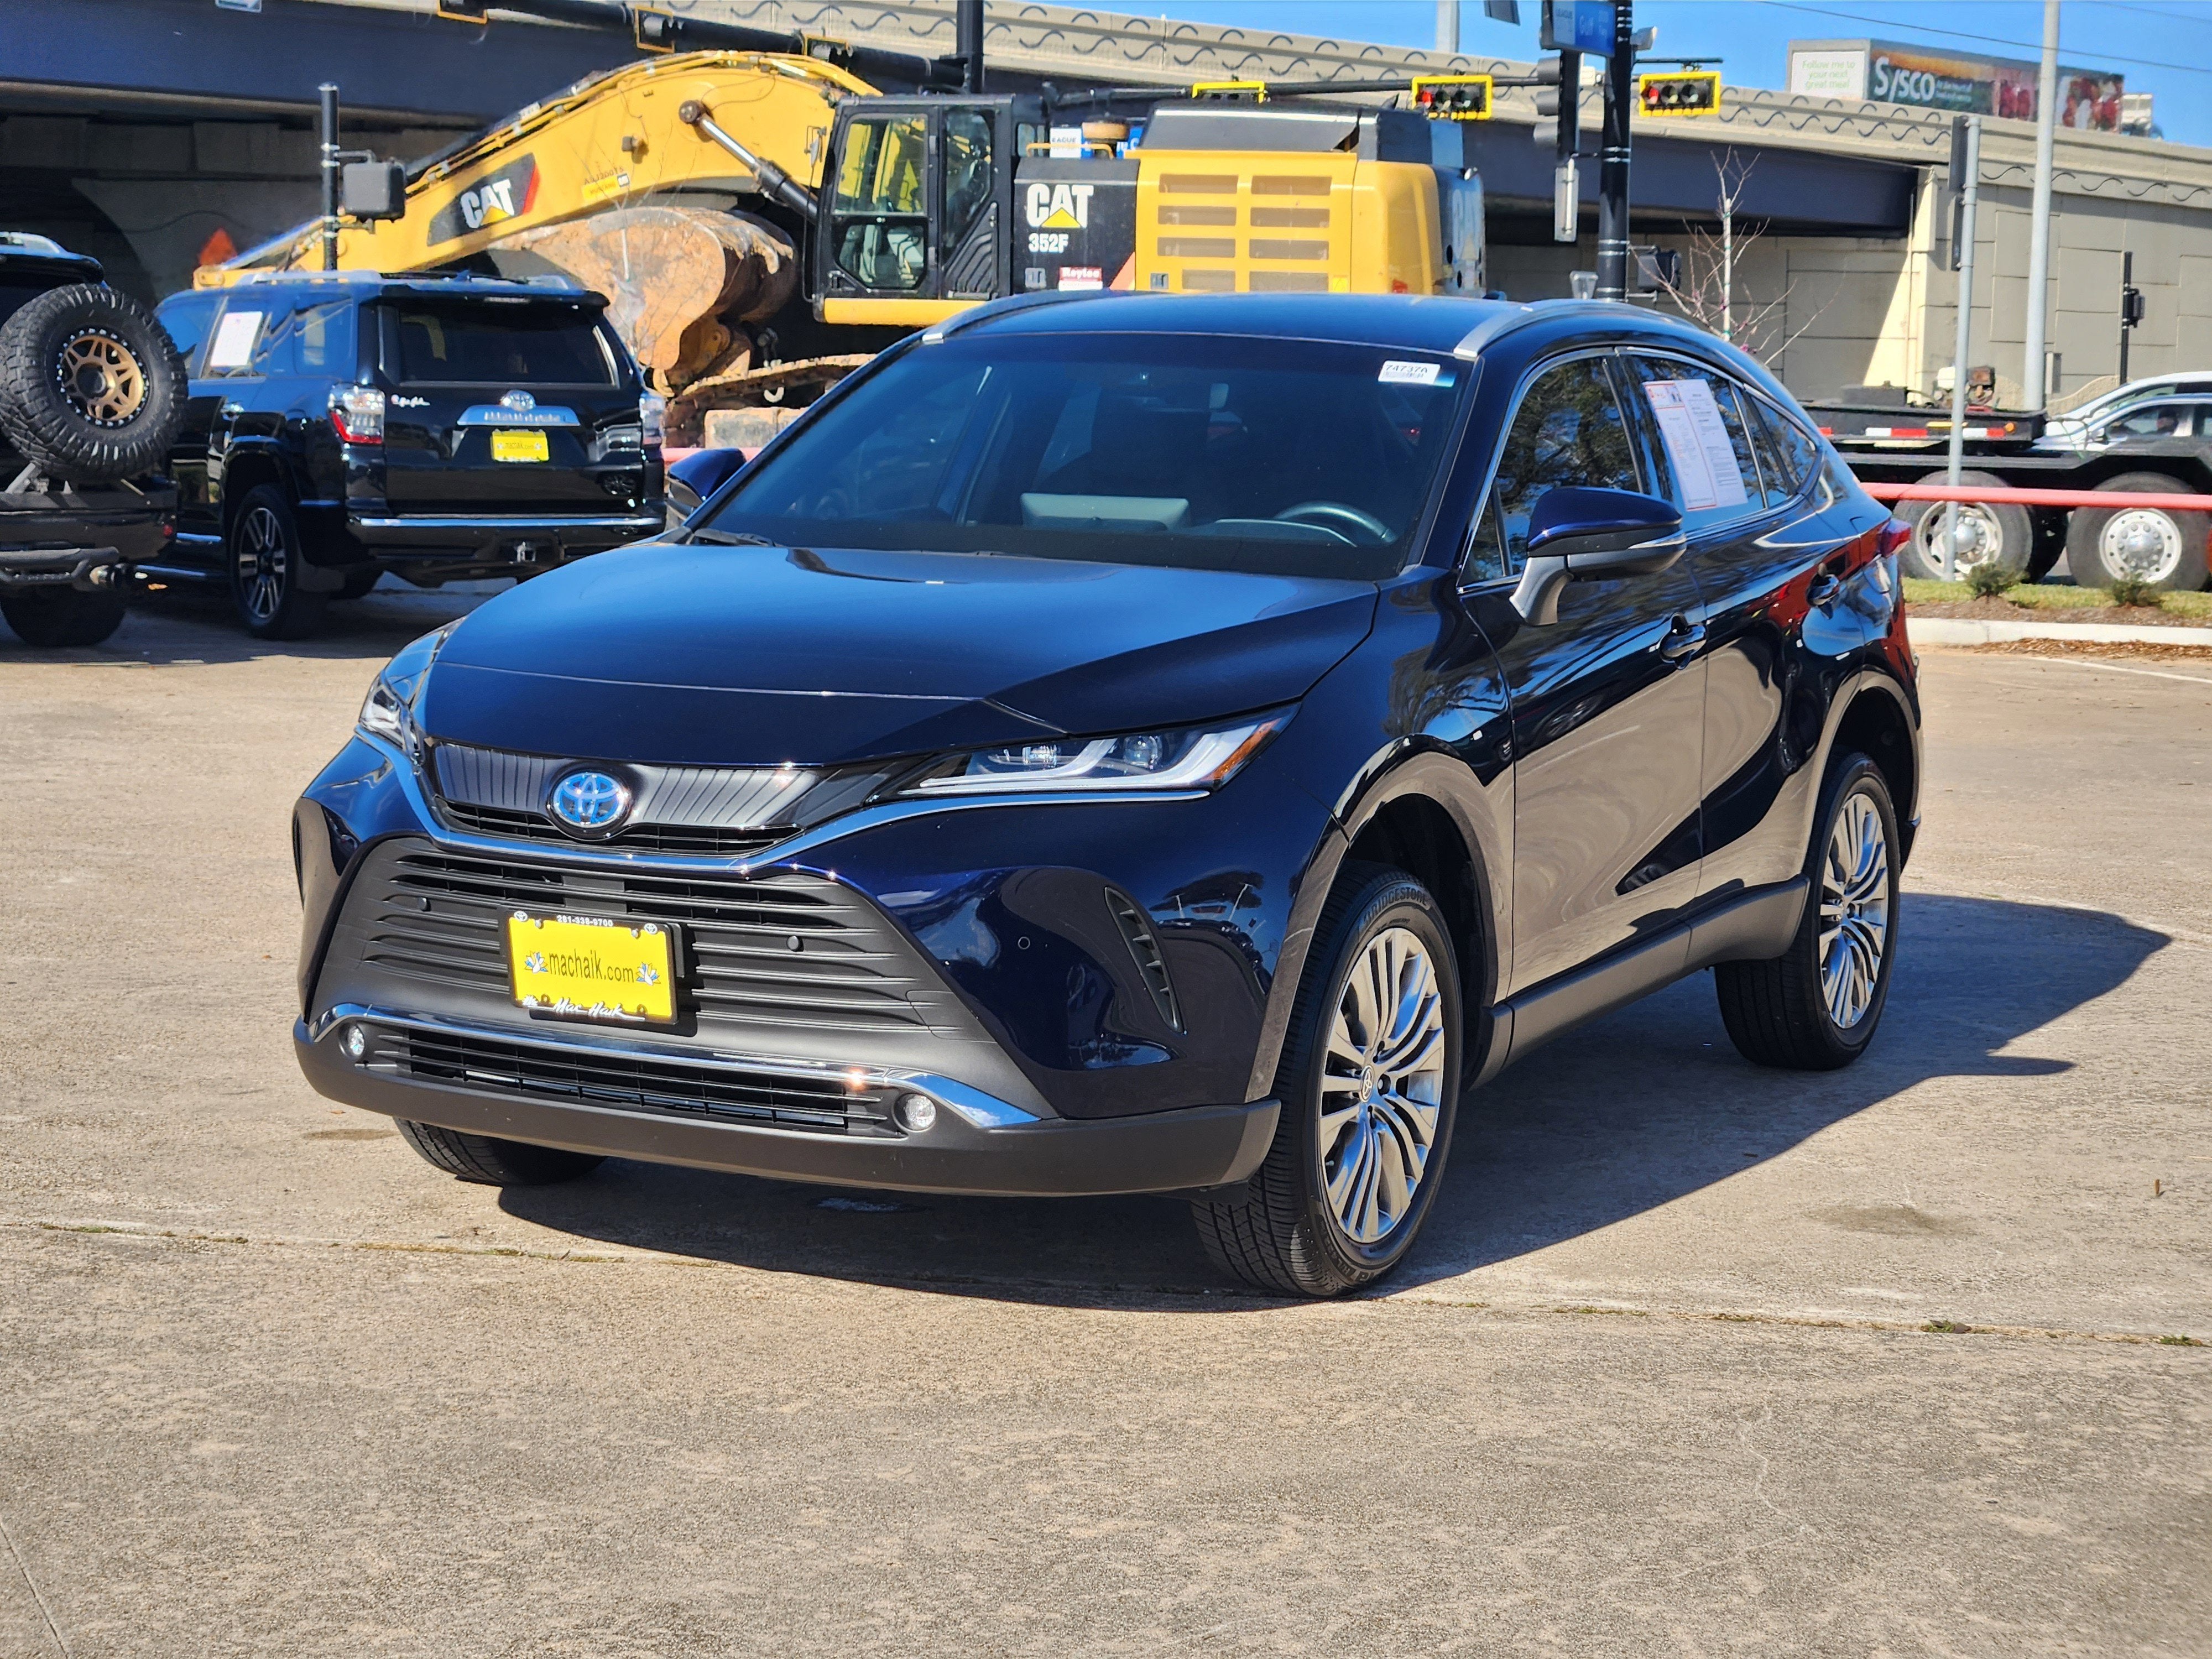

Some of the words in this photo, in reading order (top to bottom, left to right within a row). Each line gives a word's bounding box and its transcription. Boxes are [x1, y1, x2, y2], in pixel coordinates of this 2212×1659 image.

[1802, 60, 1829, 69] Follow
[1809, 71, 1827, 80] your
[460, 178, 515, 228] CAT
[1027, 183, 1094, 229] CAT
[1029, 233, 1068, 253] 352F
[1386, 364, 1428, 373] 74737A
[549, 948, 634, 983] machaik.com
